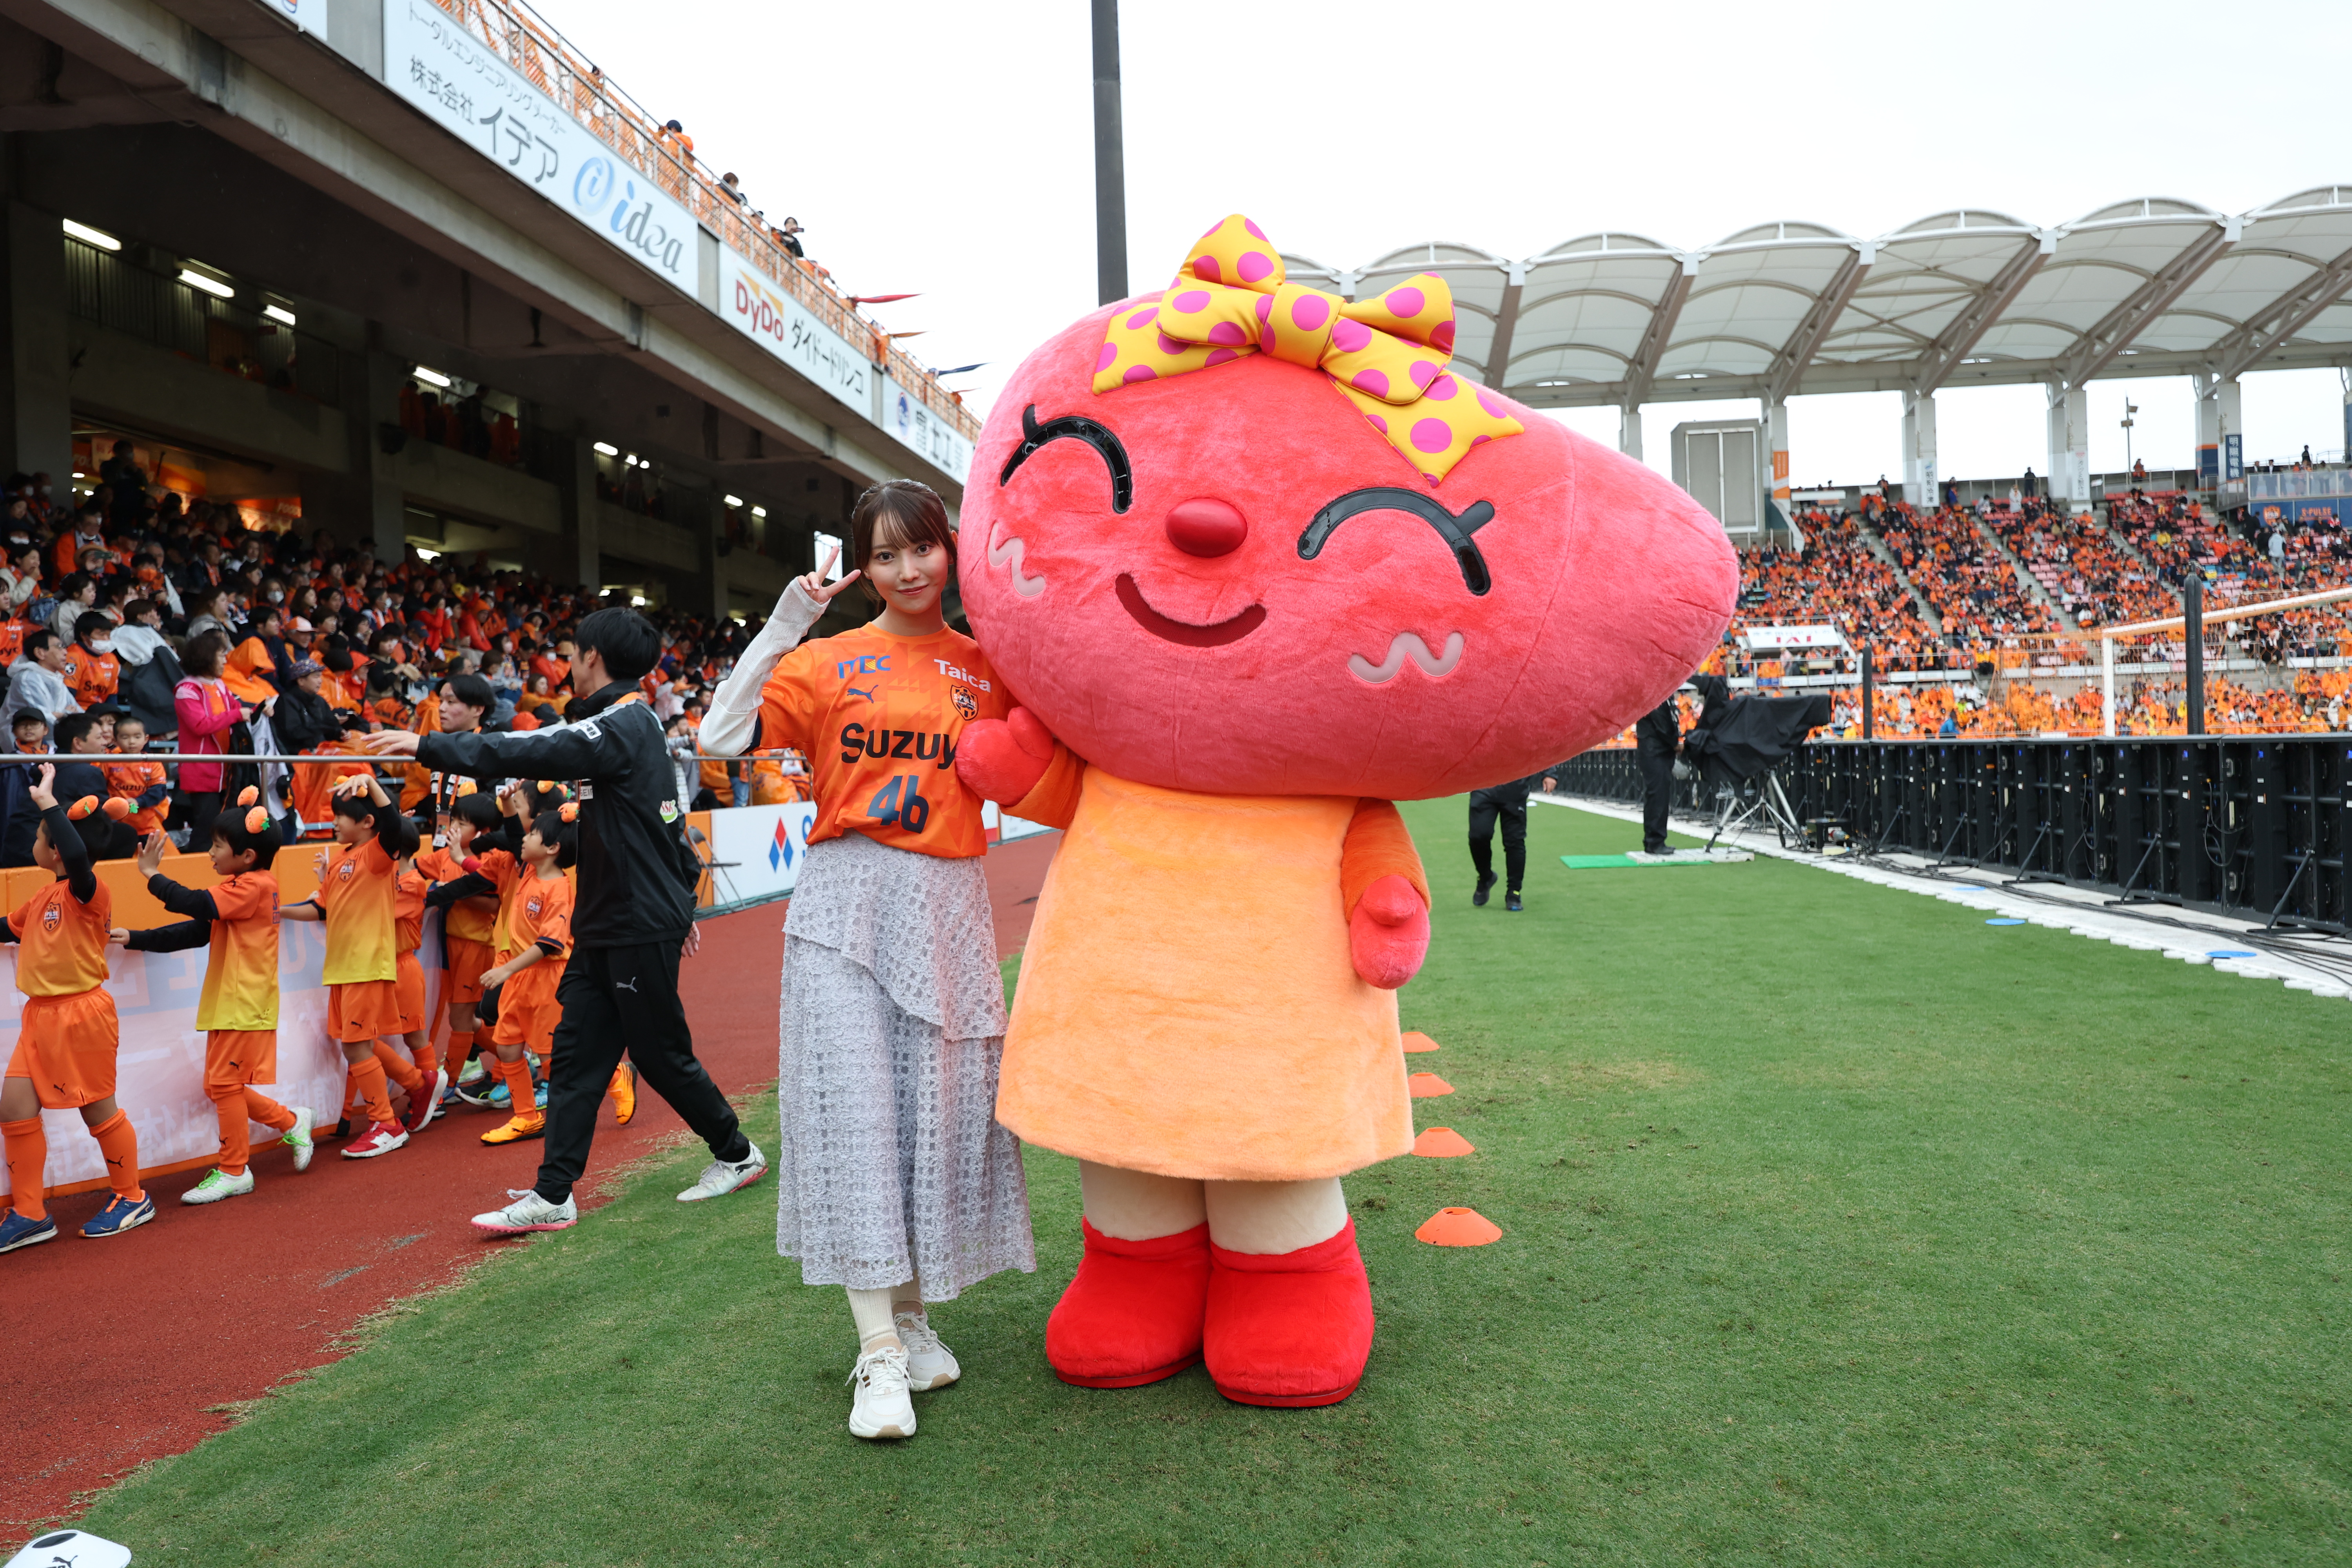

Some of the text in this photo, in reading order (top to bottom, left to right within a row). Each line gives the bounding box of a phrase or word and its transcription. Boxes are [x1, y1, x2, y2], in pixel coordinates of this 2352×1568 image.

[611, 180, 683, 274] idea
[736, 279, 863, 396] DyDo ダイドードリンコ
[934, 659, 991, 693] Taica
[840, 722, 956, 770] Suzuy
[866, 775, 929, 834] 46
